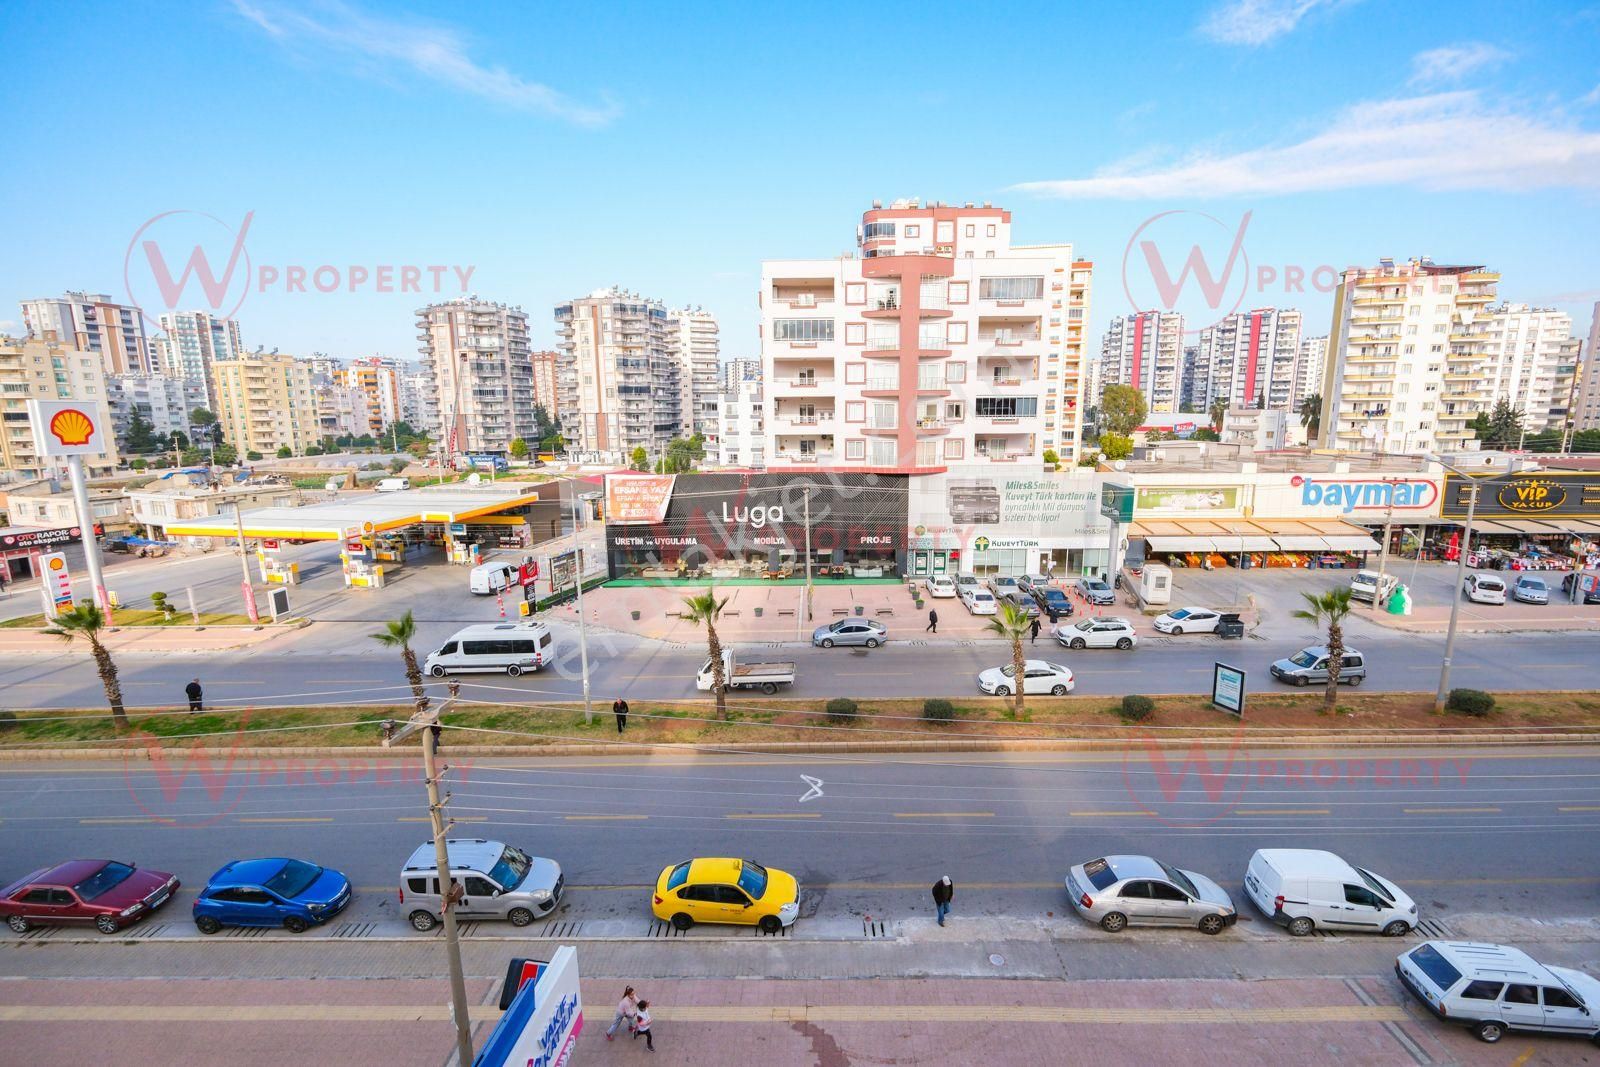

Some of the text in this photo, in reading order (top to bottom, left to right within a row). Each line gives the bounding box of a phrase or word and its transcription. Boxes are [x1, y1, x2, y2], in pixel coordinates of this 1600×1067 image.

[1005, 481, 1060, 490] Miles&Smiles
[1005, 492, 1033, 502] Kuveyt
[1035, 492, 1052, 500] Türk
[1087, 492, 1097, 500] ile
[1301, 477, 1428, 513] baymar
[1042, 503, 1055, 511] Mil
[722, 501, 784, 528] Luga
[33, 535, 70, 545] ekspertiz
[615, 537, 644, 545] ÜRETİM
[655, 537, 698, 545] UYGULAMA
[754, 536, 786, 545] MOBİLYA
[860, 536, 892, 544] PROJE
[540, 994, 567, 1050] VAKIF
